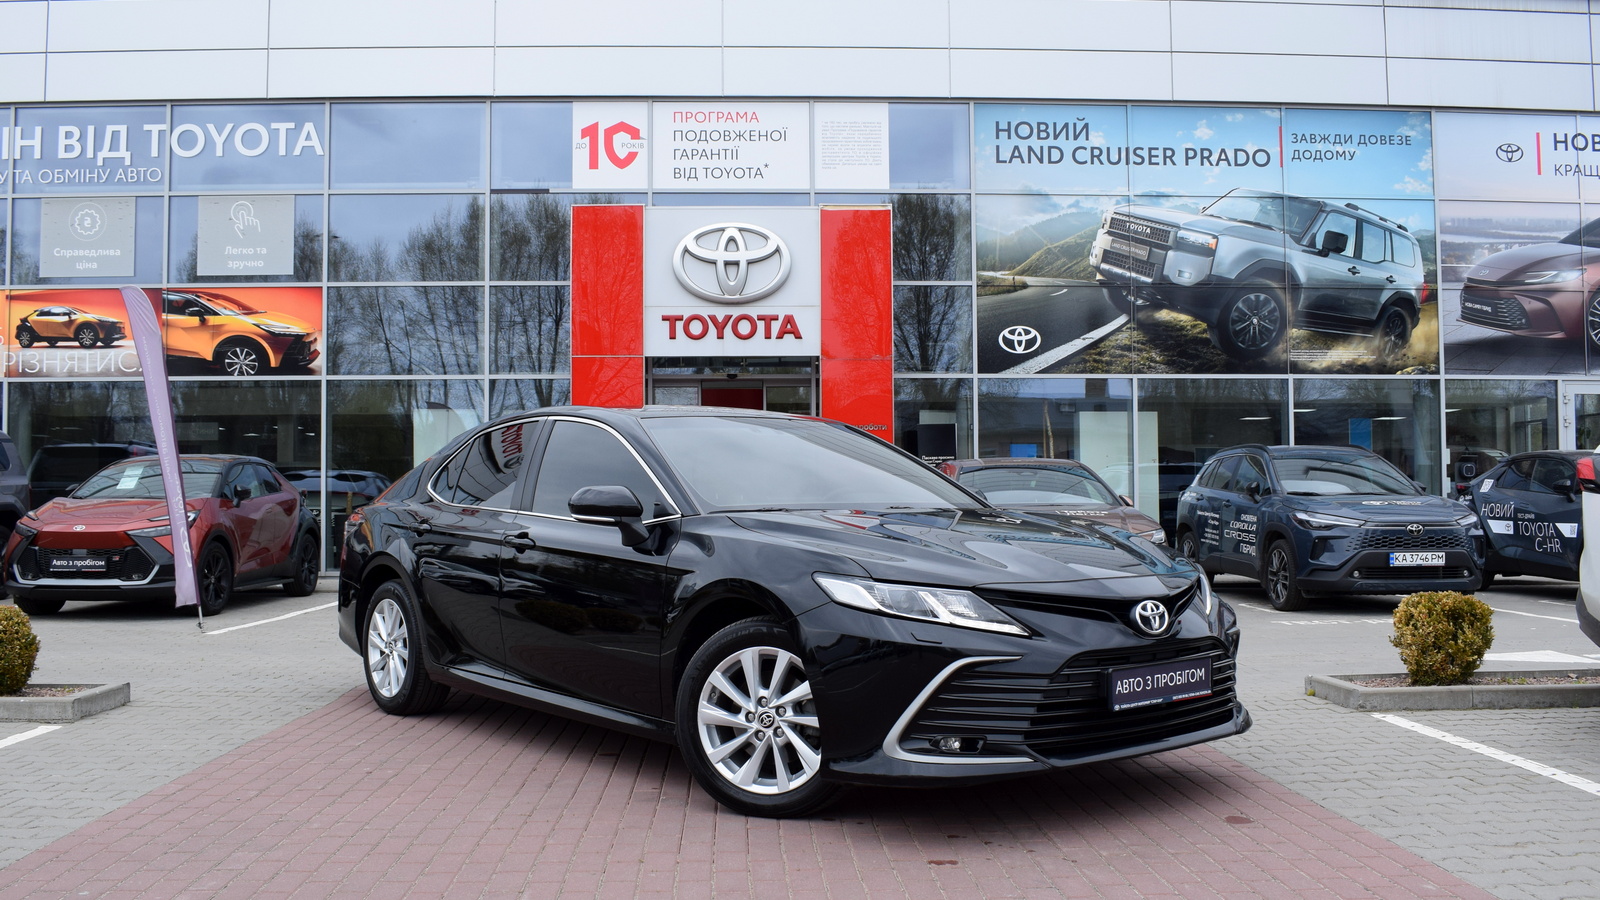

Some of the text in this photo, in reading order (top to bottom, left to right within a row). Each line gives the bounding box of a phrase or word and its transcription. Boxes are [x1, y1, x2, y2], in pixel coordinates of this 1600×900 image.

[673, 111, 760, 124] ПРОГРАМА
[673, 126, 788, 144] ПОДОВЖЕНОЇ
[994, 117, 1090, 141] НОВИЙ
[57, 124, 132, 166] ВІД
[144, 122, 325, 158] TOYOTA
[1290, 132, 1412, 148] ЗАВЖДИ ДОВЕЗЕ
[1554, 132, 1600, 152] НОВ
[673, 146, 740, 160] ГАРАНТІЇ
[995, 145, 1272, 168] LAND CRUISER PRADO
[1291, 148, 1356, 162] ДОДОМУ
[13, 170, 33, 184] ТА
[38, 168, 110, 184] ОБМІНУ
[114, 168, 162, 183] АВТО
[673, 167, 698, 182] ВІД
[1126, 222, 1150, 234] TOYOTA
[54, 248, 121, 258] Справедлива
[224, 246, 267, 256] Легко та
[76, 260, 98, 271] ціна
[227, 259, 264, 269] зручно
[662, 314, 802, 340] TOYOTA
[4, 351, 142, 373] РІЗНЯТИС
[1481, 502, 1514, 518] НОВИЙ
[1230, 521, 1256, 531] COROLLA
[1518, 521, 1556, 537] TOYOTA
[1224, 530, 1256, 542] CROSS
[1535, 538, 1562, 553] C-HR
[1395, 554, 1444, 563] KA 3746 PM
[1116, 668, 1204, 694] АВТО З ПРОБІГОМ
